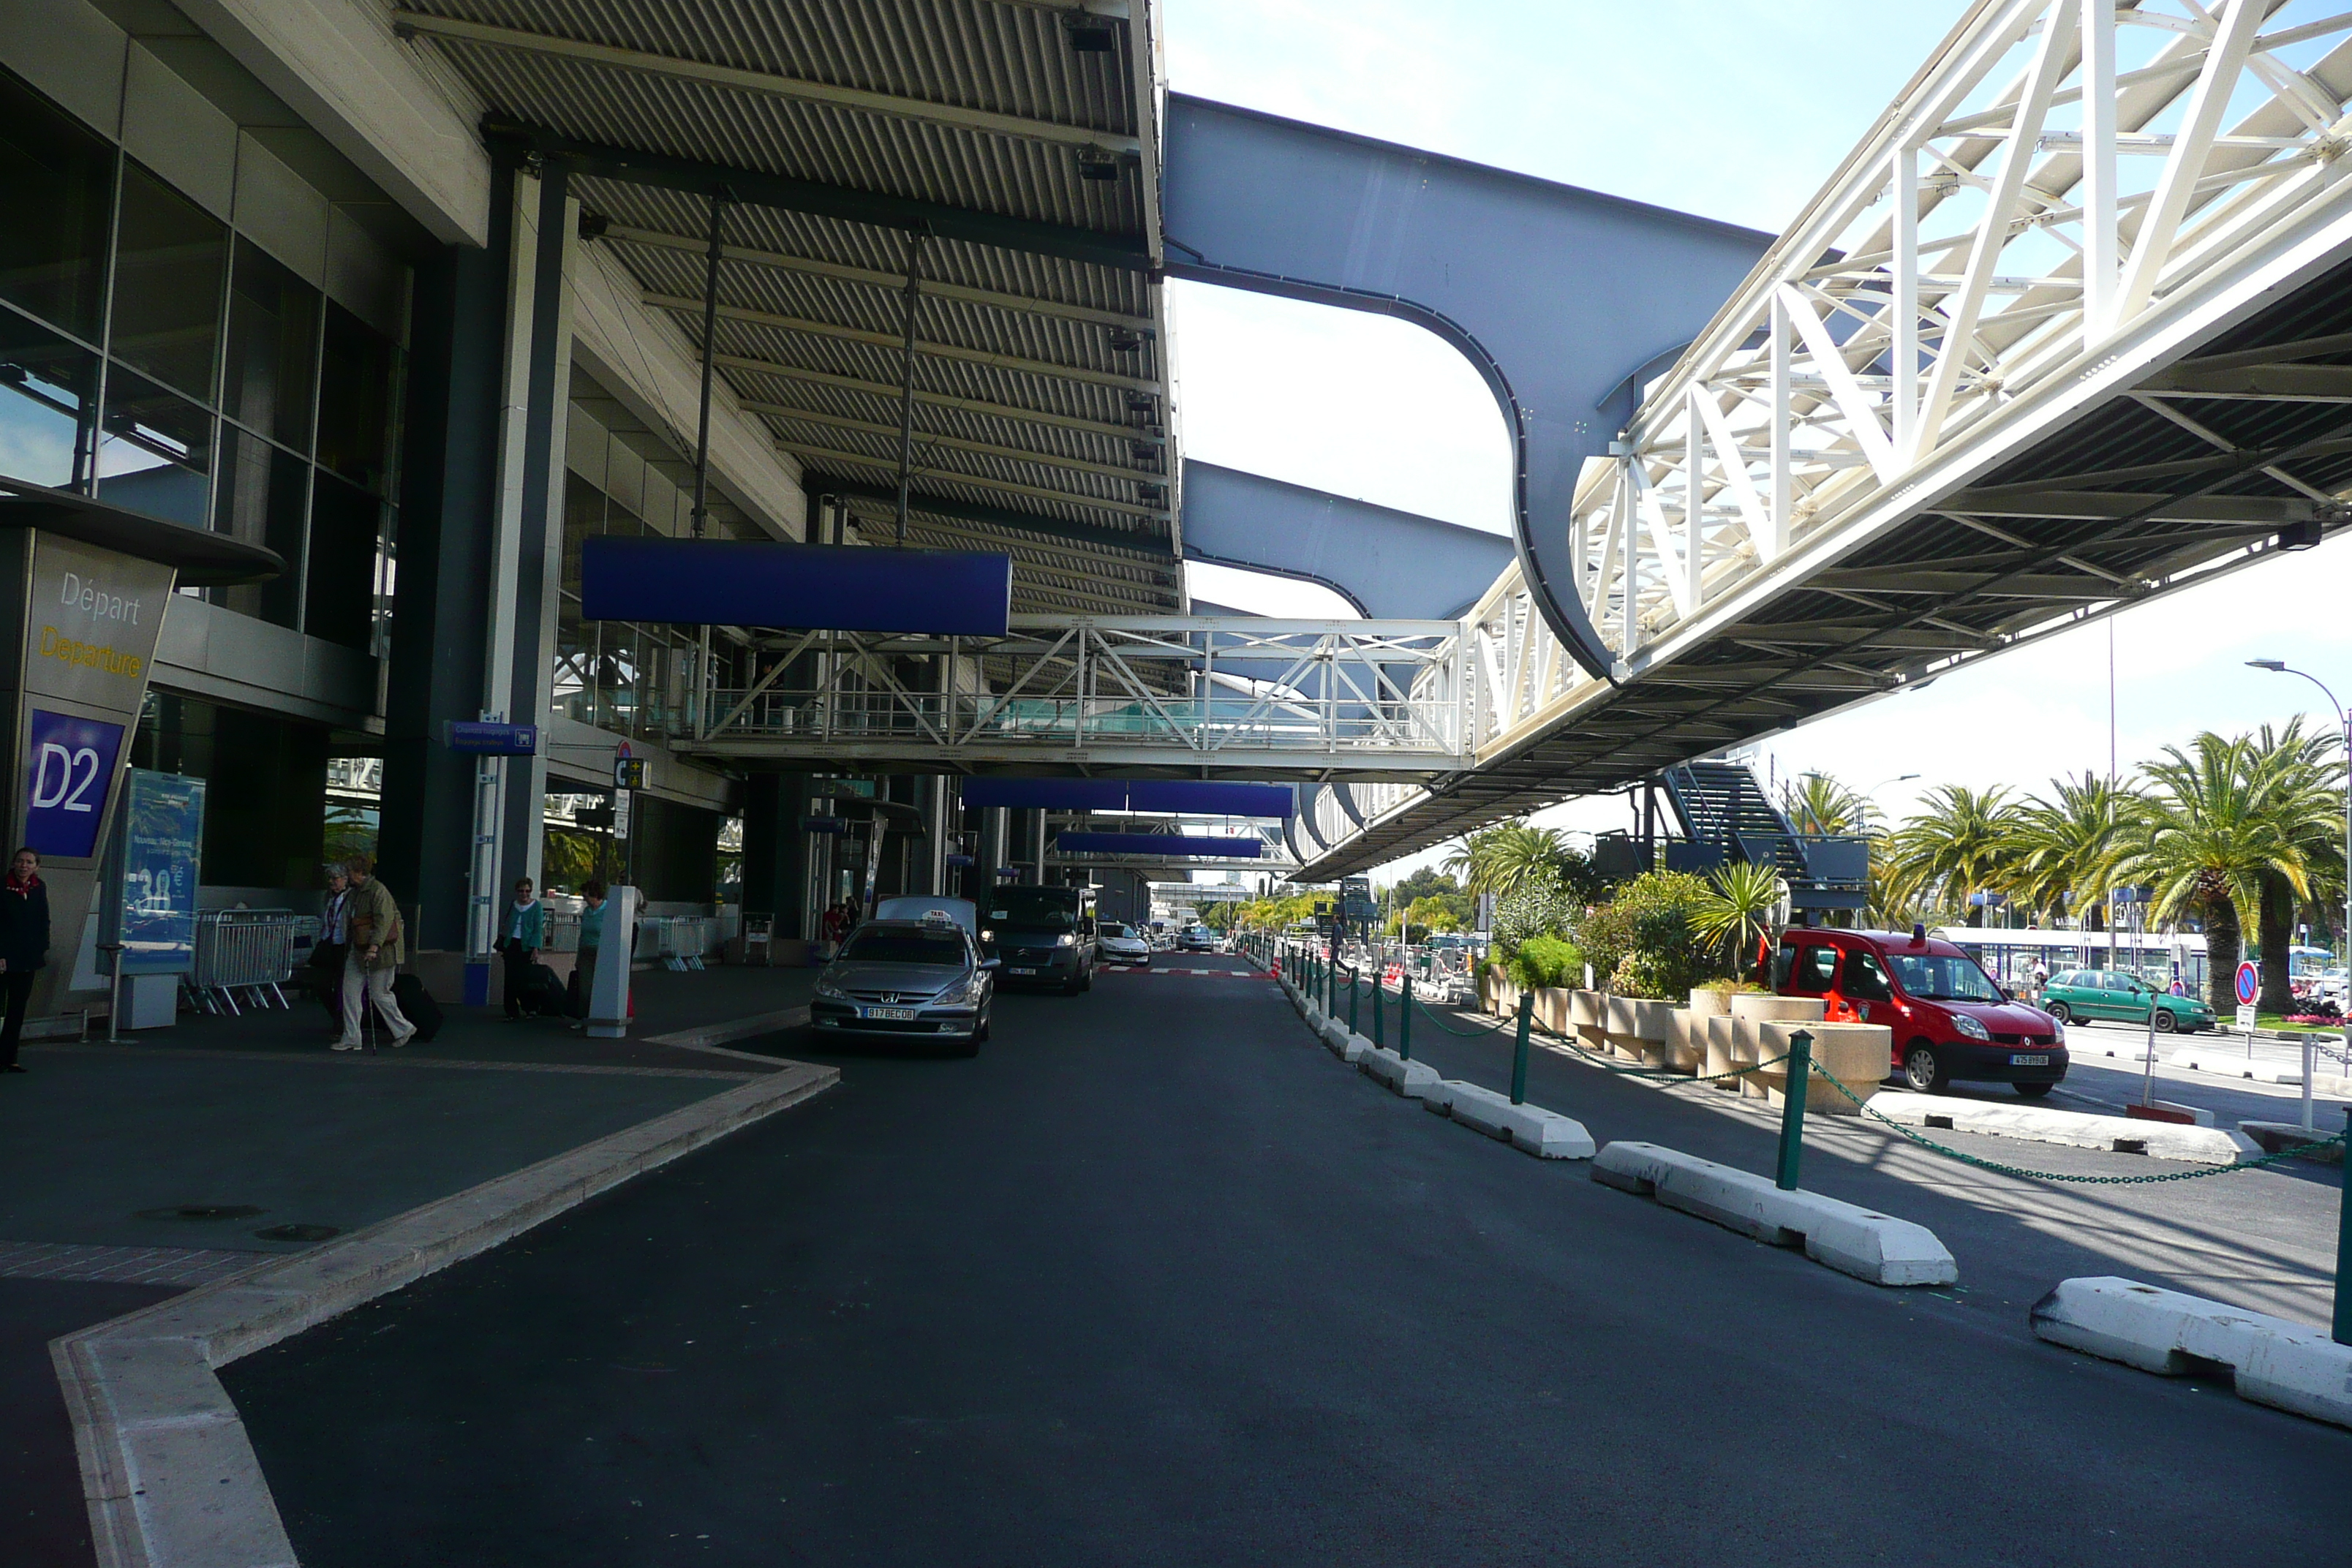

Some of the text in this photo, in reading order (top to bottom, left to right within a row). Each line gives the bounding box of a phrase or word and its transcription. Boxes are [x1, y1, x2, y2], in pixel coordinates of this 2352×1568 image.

[61, 572, 140, 625] Départ
[39, 626, 142, 678] Departure
[33, 743, 99, 812] D2
